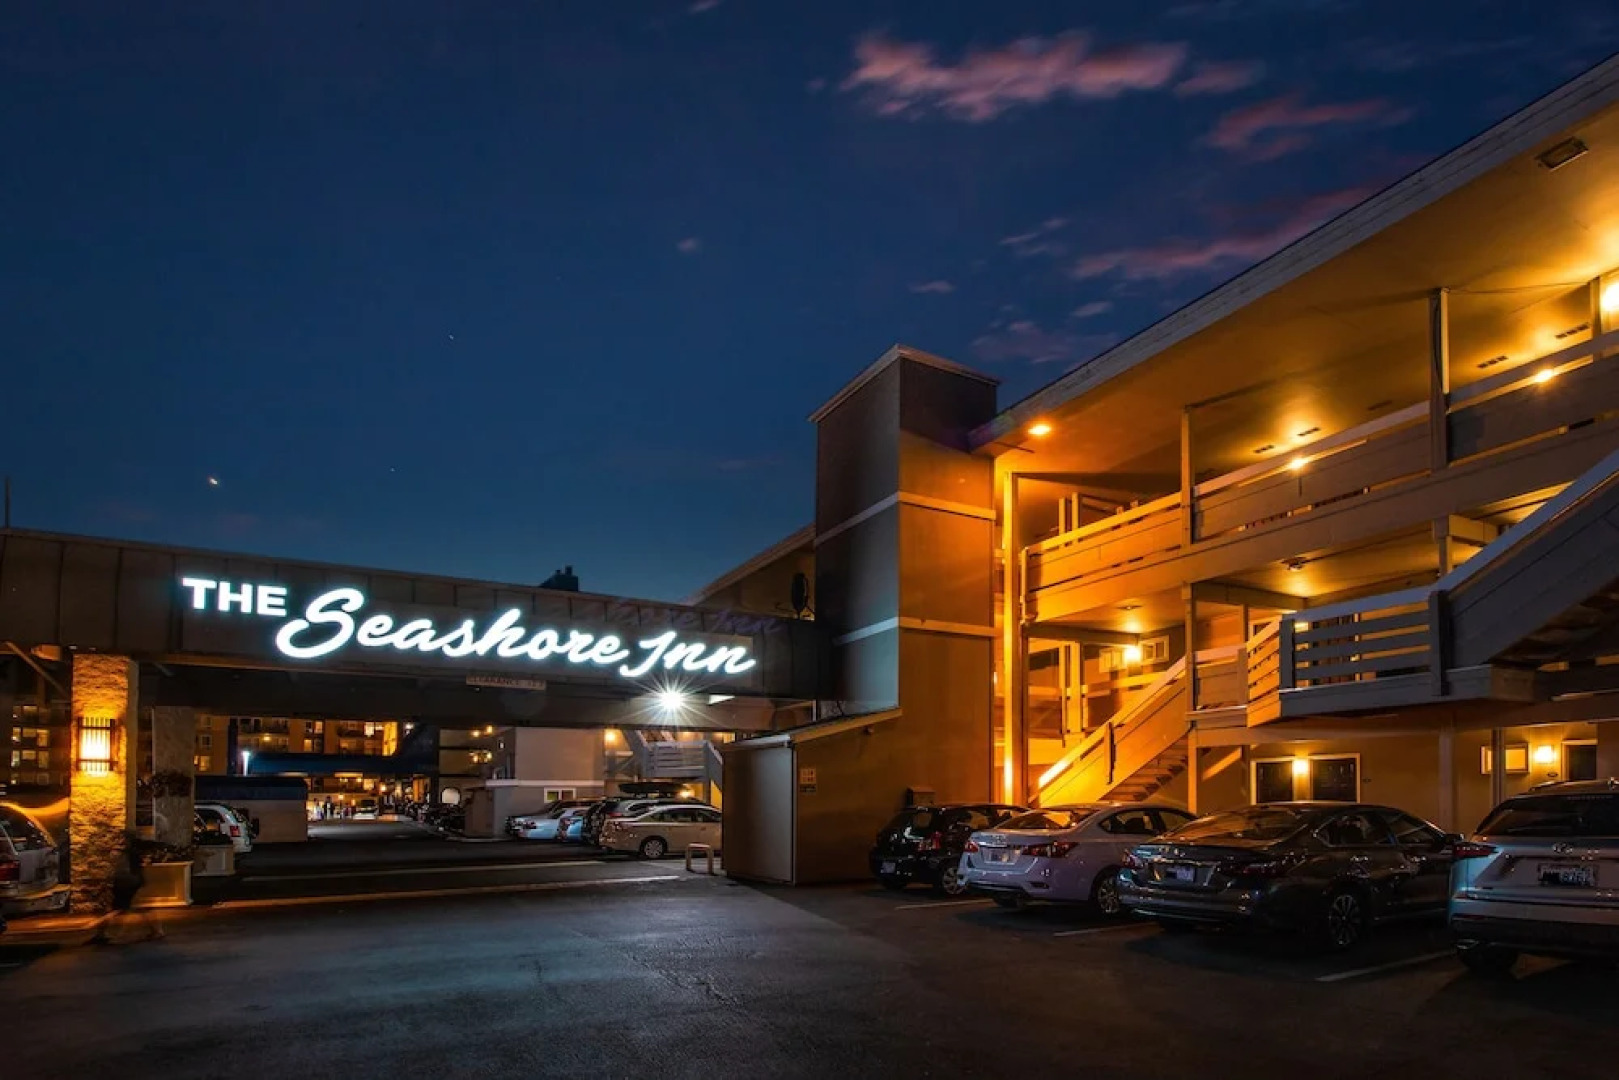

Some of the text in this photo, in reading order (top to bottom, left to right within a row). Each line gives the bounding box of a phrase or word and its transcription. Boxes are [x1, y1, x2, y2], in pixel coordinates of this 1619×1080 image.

[182, 577, 757, 678] THE Seashore Inn
